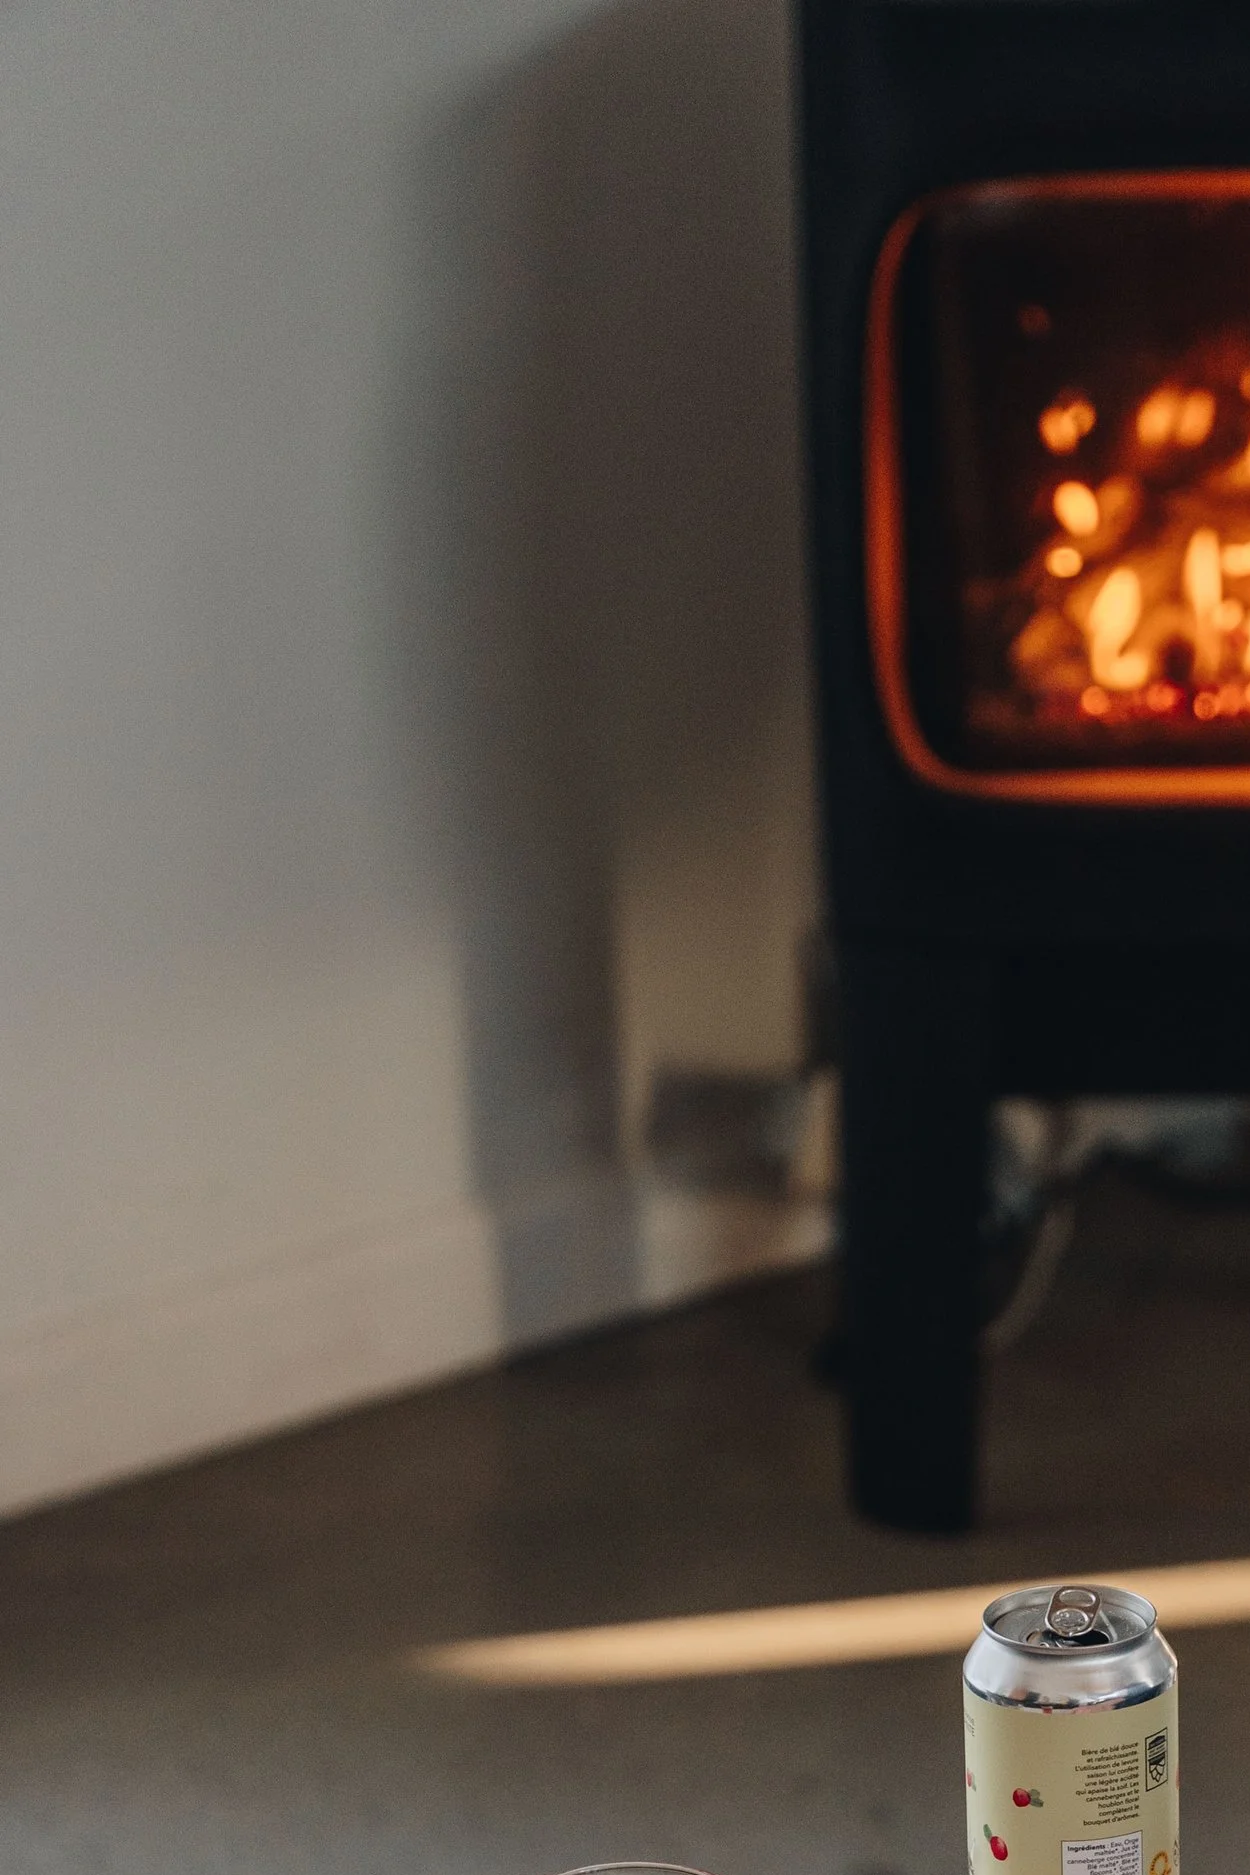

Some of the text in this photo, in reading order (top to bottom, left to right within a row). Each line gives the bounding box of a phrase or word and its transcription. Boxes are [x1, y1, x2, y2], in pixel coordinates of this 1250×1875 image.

[1121, 1742, 1138, 1750] douce
[1086, 1793, 1125, 1802] canneberges
[1098, 1800, 1123, 1808] houblon
